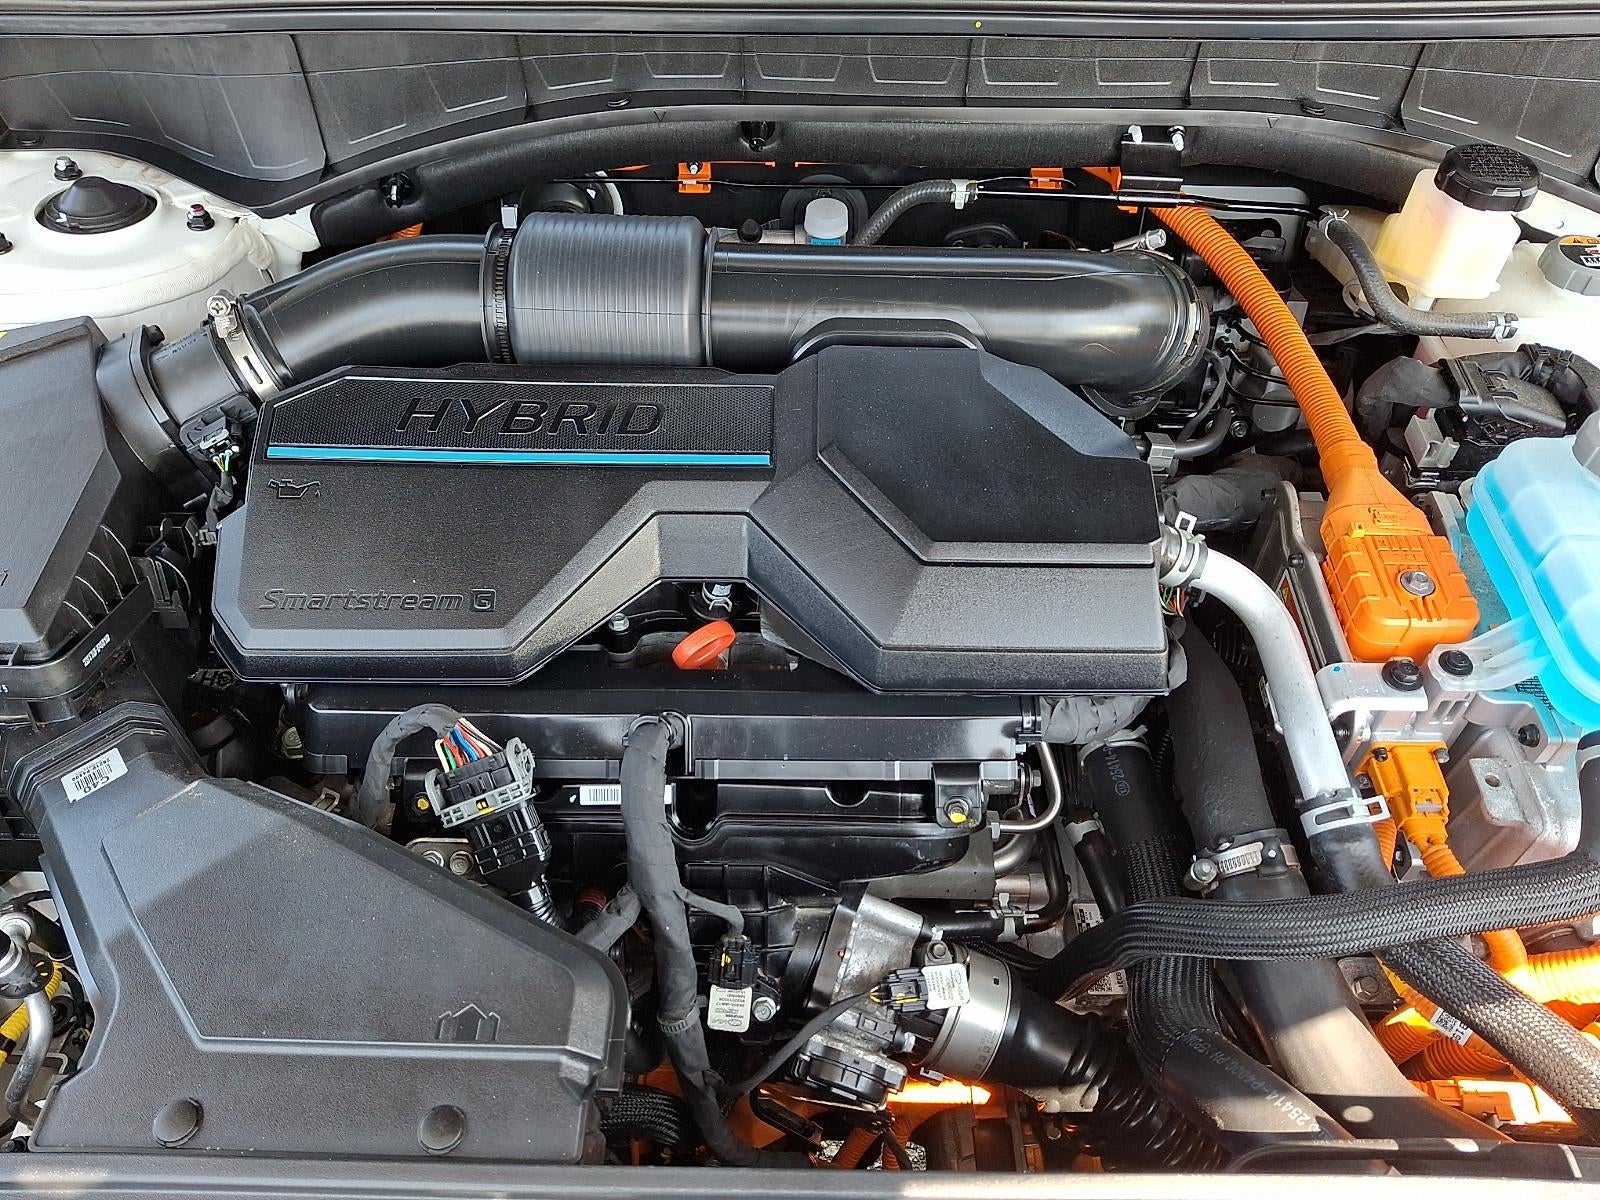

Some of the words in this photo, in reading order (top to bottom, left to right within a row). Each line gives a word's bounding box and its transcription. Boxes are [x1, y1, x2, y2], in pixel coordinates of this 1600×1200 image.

[395, 399, 666, 435] HYBRID
[259, 588, 464, 610] Smartstream
[470, 589, 497, 612] G
[83, 775, 110, 793] C40
